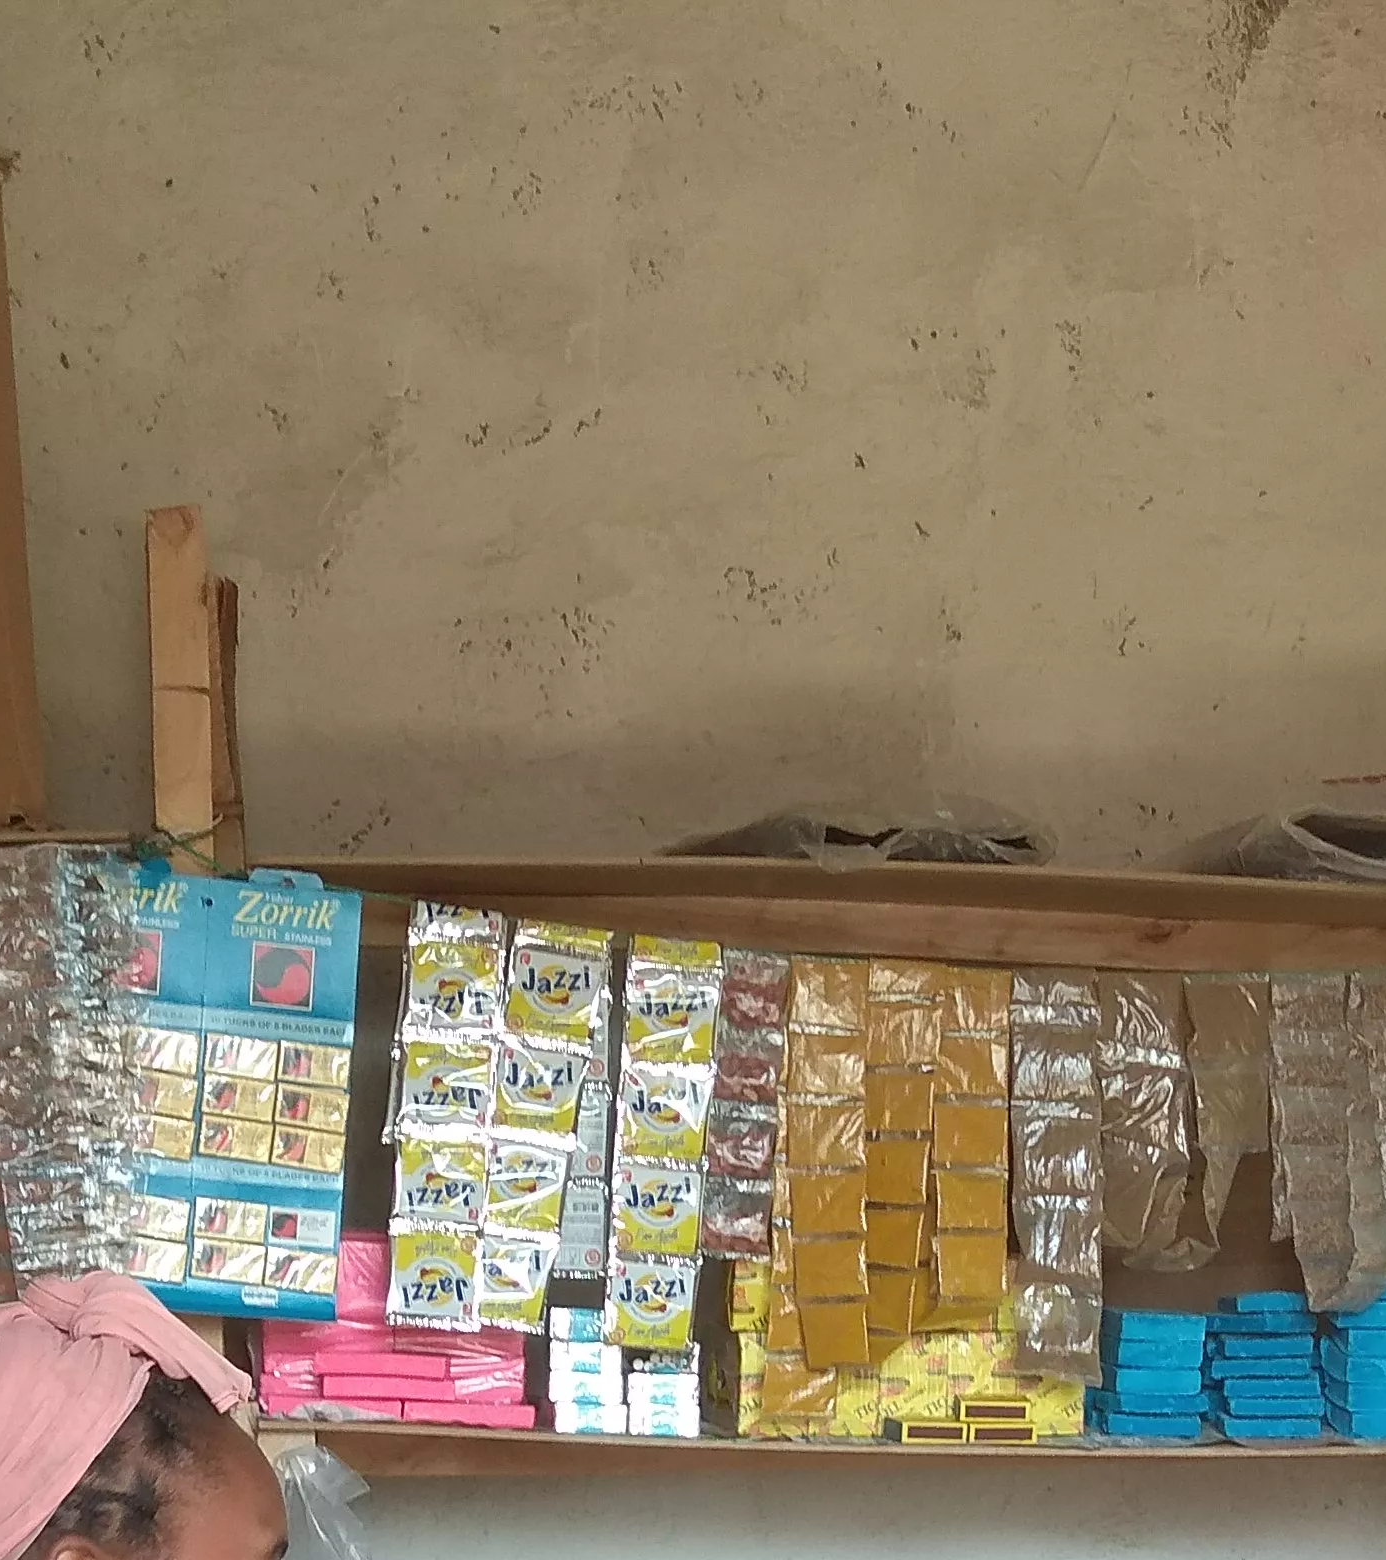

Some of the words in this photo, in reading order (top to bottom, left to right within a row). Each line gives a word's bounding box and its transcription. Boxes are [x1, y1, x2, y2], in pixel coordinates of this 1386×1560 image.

[234, 889, 336, 931] Zorrik
[521, 964, 591, 993] Jazzi
[406, 1182, 476, 1214] Jazzi
[625, 1176, 692, 1208] Jazzi
[401, 1276, 470, 1309] Jazzi
[618, 1270, 687, 1304] Jazzi
